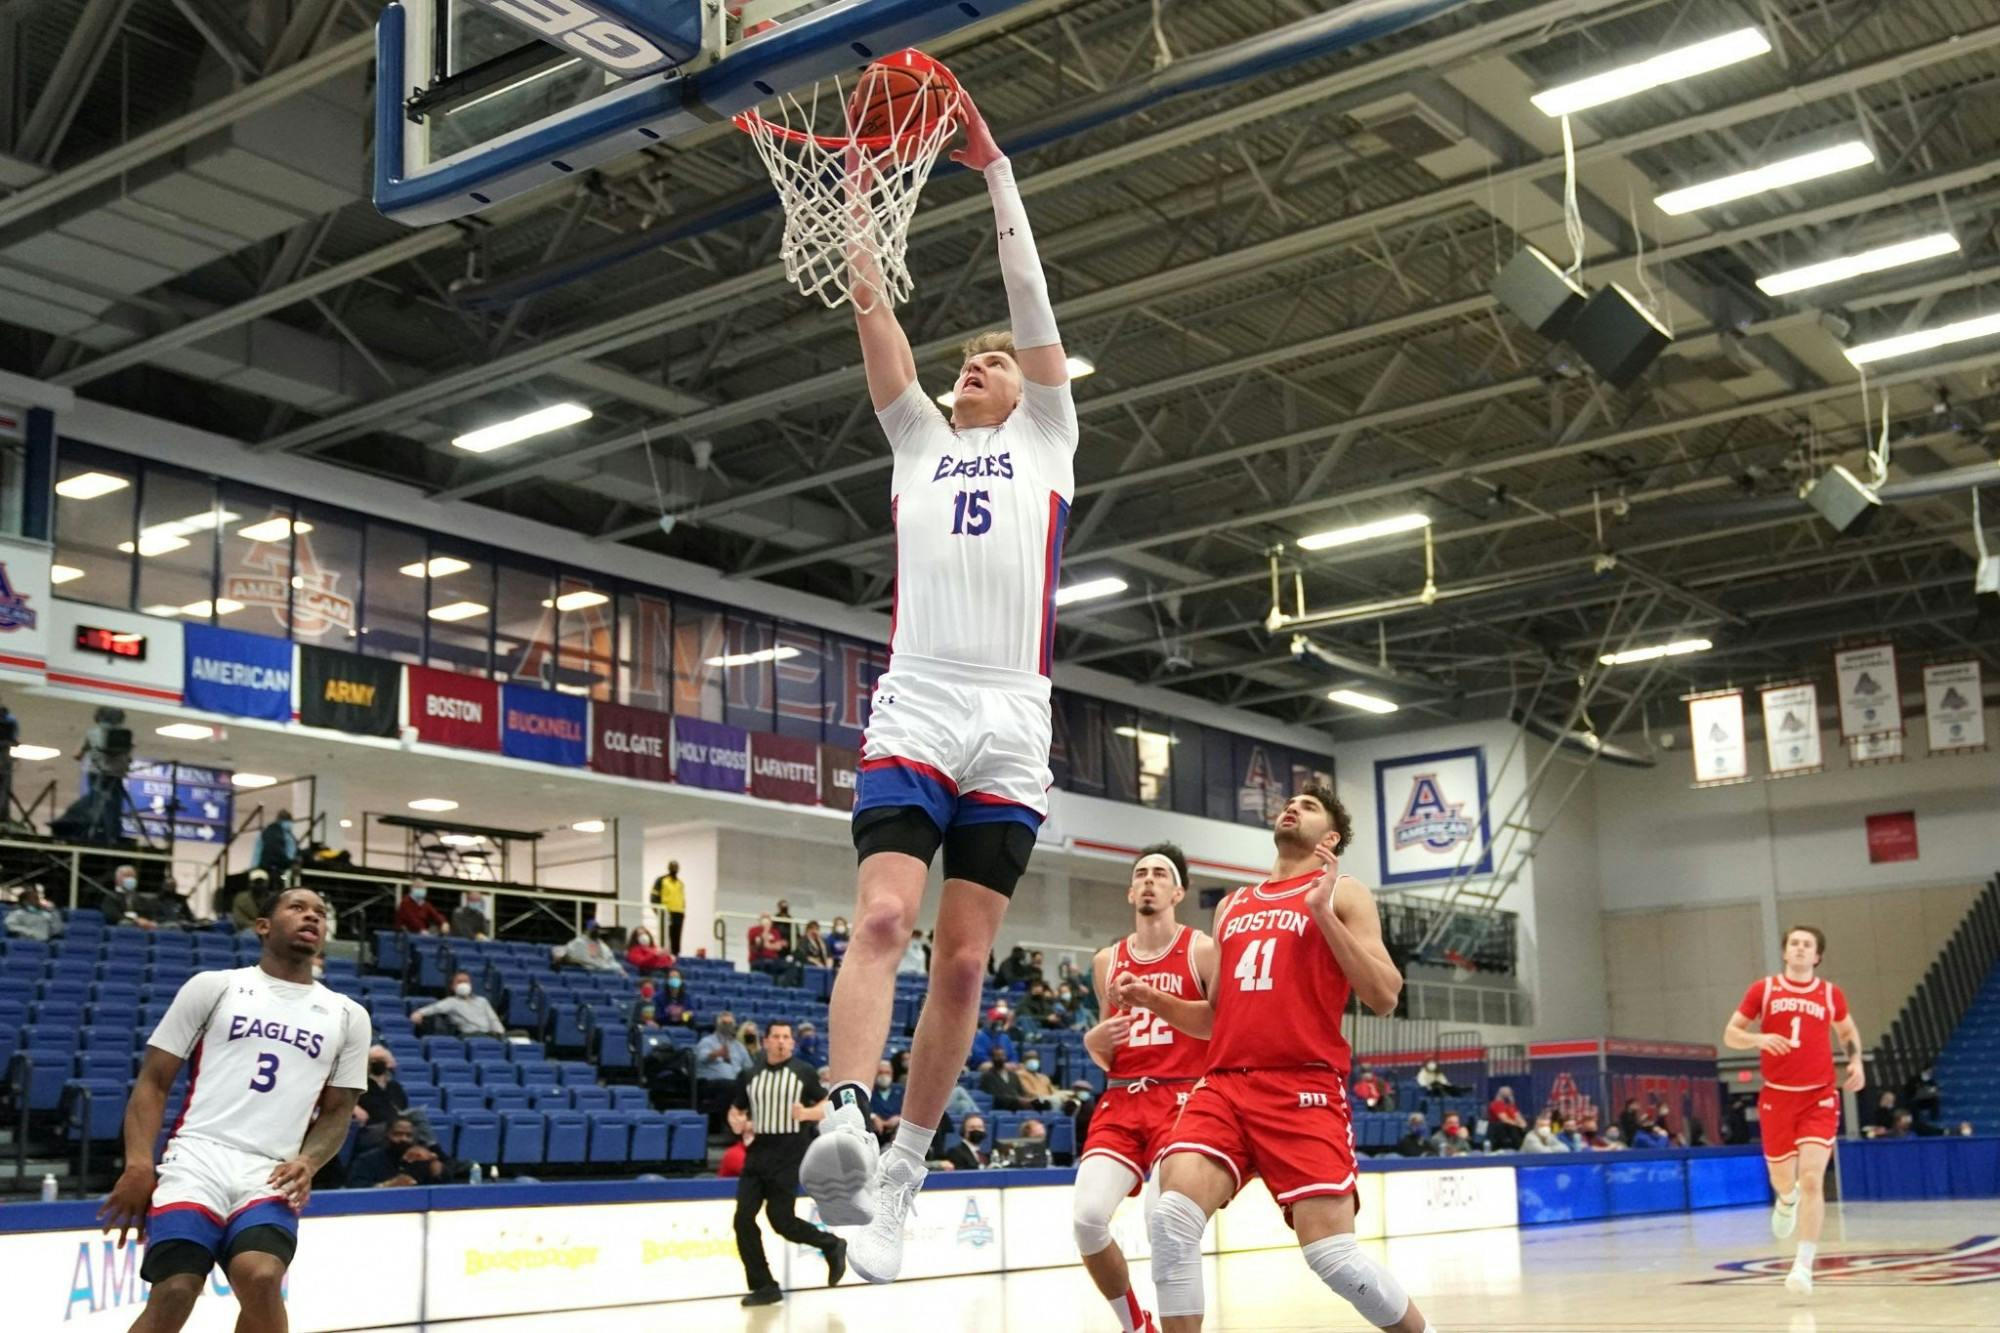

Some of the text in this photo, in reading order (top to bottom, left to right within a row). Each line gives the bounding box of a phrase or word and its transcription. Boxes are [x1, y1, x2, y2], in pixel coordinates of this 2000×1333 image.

[932, 452, 1013, 482] EAGLES
[950, 489, 992, 536] 15
[191, 657, 289, 691] AMERICAN
[324, 679, 375, 706] ARMY
[426, 694, 482, 723] BOSTON
[508, 710, 581, 741] BUCKNELL
[604, 730, 663, 757] COLGATE
[677, 742, 747, 770] HOLY CROSS
[754, 756, 816, 783] LAFAYETTE
[1223, 909, 1309, 942] BOSTON
[1234, 938, 1277, 991] 41
[1138, 972, 1183, 995] STON
[1771, 997, 1825, 1020] BOSTON
[229, 1015, 324, 1059] EAGLES
[1128, 1006, 1174, 1047] 22
[1790, 1016, 1801, 1048] 1
[250, 1052, 280, 1093] 3
[1299, 1092, 1327, 1107] BU
